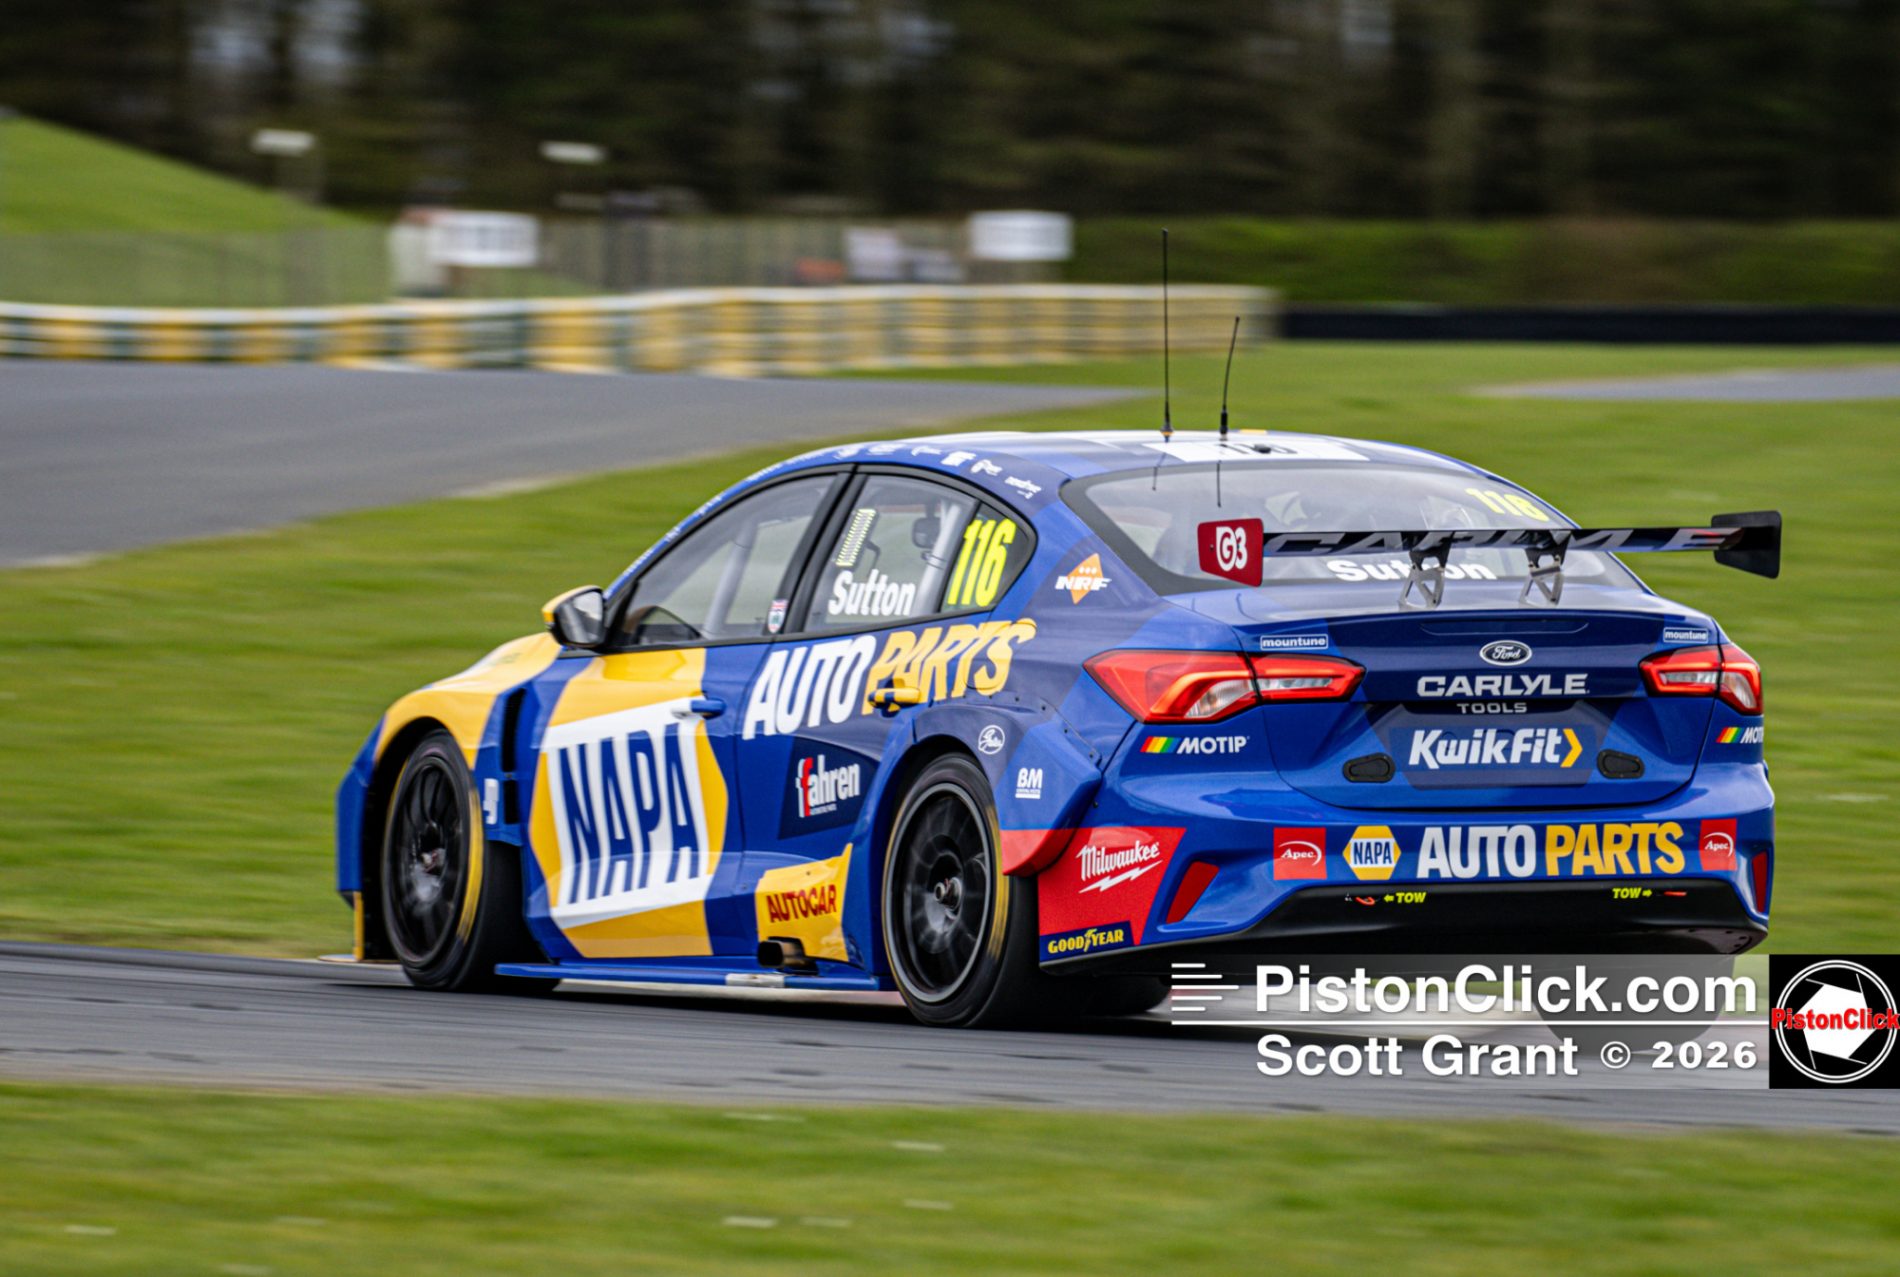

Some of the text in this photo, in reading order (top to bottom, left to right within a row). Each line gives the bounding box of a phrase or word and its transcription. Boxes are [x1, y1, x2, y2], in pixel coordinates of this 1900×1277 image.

[1464, 488, 1550, 522] 116
[947, 518, 1016, 607] 116
[1327, 560, 1498, 581] Suton
[828, 569, 916, 617] Sutton
[1055, 575, 1112, 591] NRF
[1262, 637, 1326, 647] mountune
[1664, 630, 1707, 640] mountune
[1492, 645, 1522, 660] Ford
[742, 618, 1037, 740] AUTO PARTS
[1416, 673, 1590, 697] CARLYLE
[1457, 702, 1528, 714] TOOLS
[1176, 736, 1247, 754] MOTIP
[1017, 768, 1043, 789] BM
[560, 722, 700, 905] NAPA
[1281, 848, 1316, 860] Apec
[1353, 821, 1686, 879] NAPA AUTO PARTS
[1076, 840, 1161, 882] Milwaukee
[766, 884, 837, 923] AUTOCAR
[1396, 891, 1427, 904] TOW
[1612, 887, 1642, 899] TOW
[1047, 928, 1125, 954] GOODYEAR
